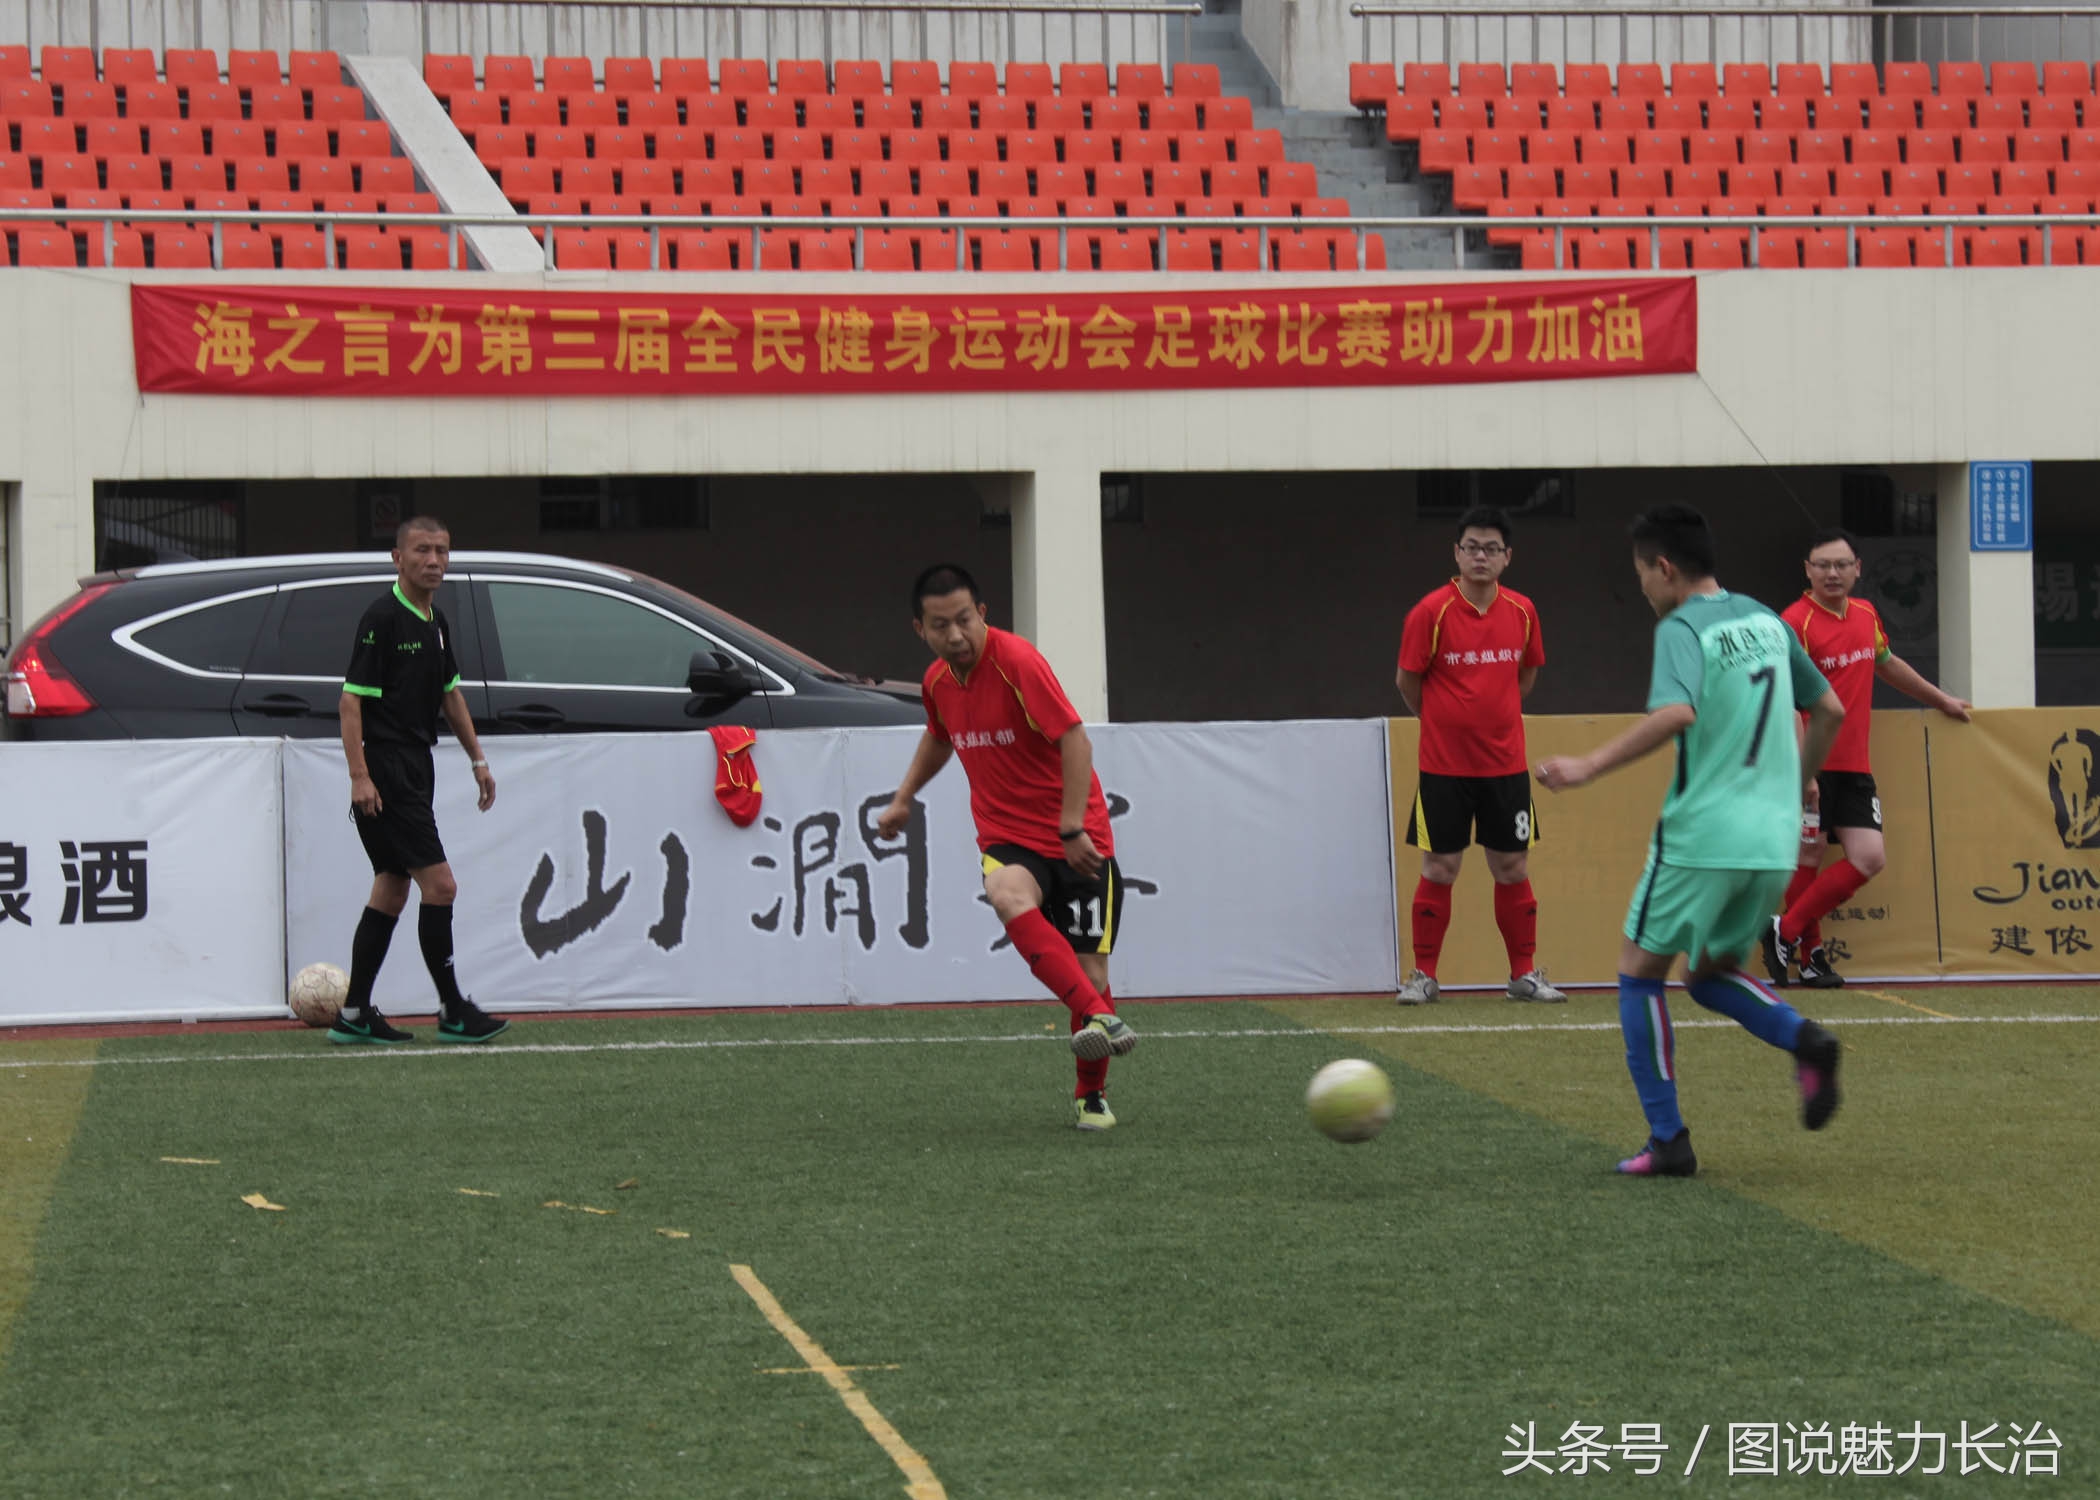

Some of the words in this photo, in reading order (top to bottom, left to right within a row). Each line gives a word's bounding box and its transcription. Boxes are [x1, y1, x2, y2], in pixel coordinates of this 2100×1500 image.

[192, 293, 1644, 377] 海之言为第三届全民健身运动会足球比赛助力加油
[1743, 666, 1776, 767] 7
[1514, 810, 1530, 841] 8
[1067, 896, 1104, 937] 11
[2051, 895, 2100, 911] out
